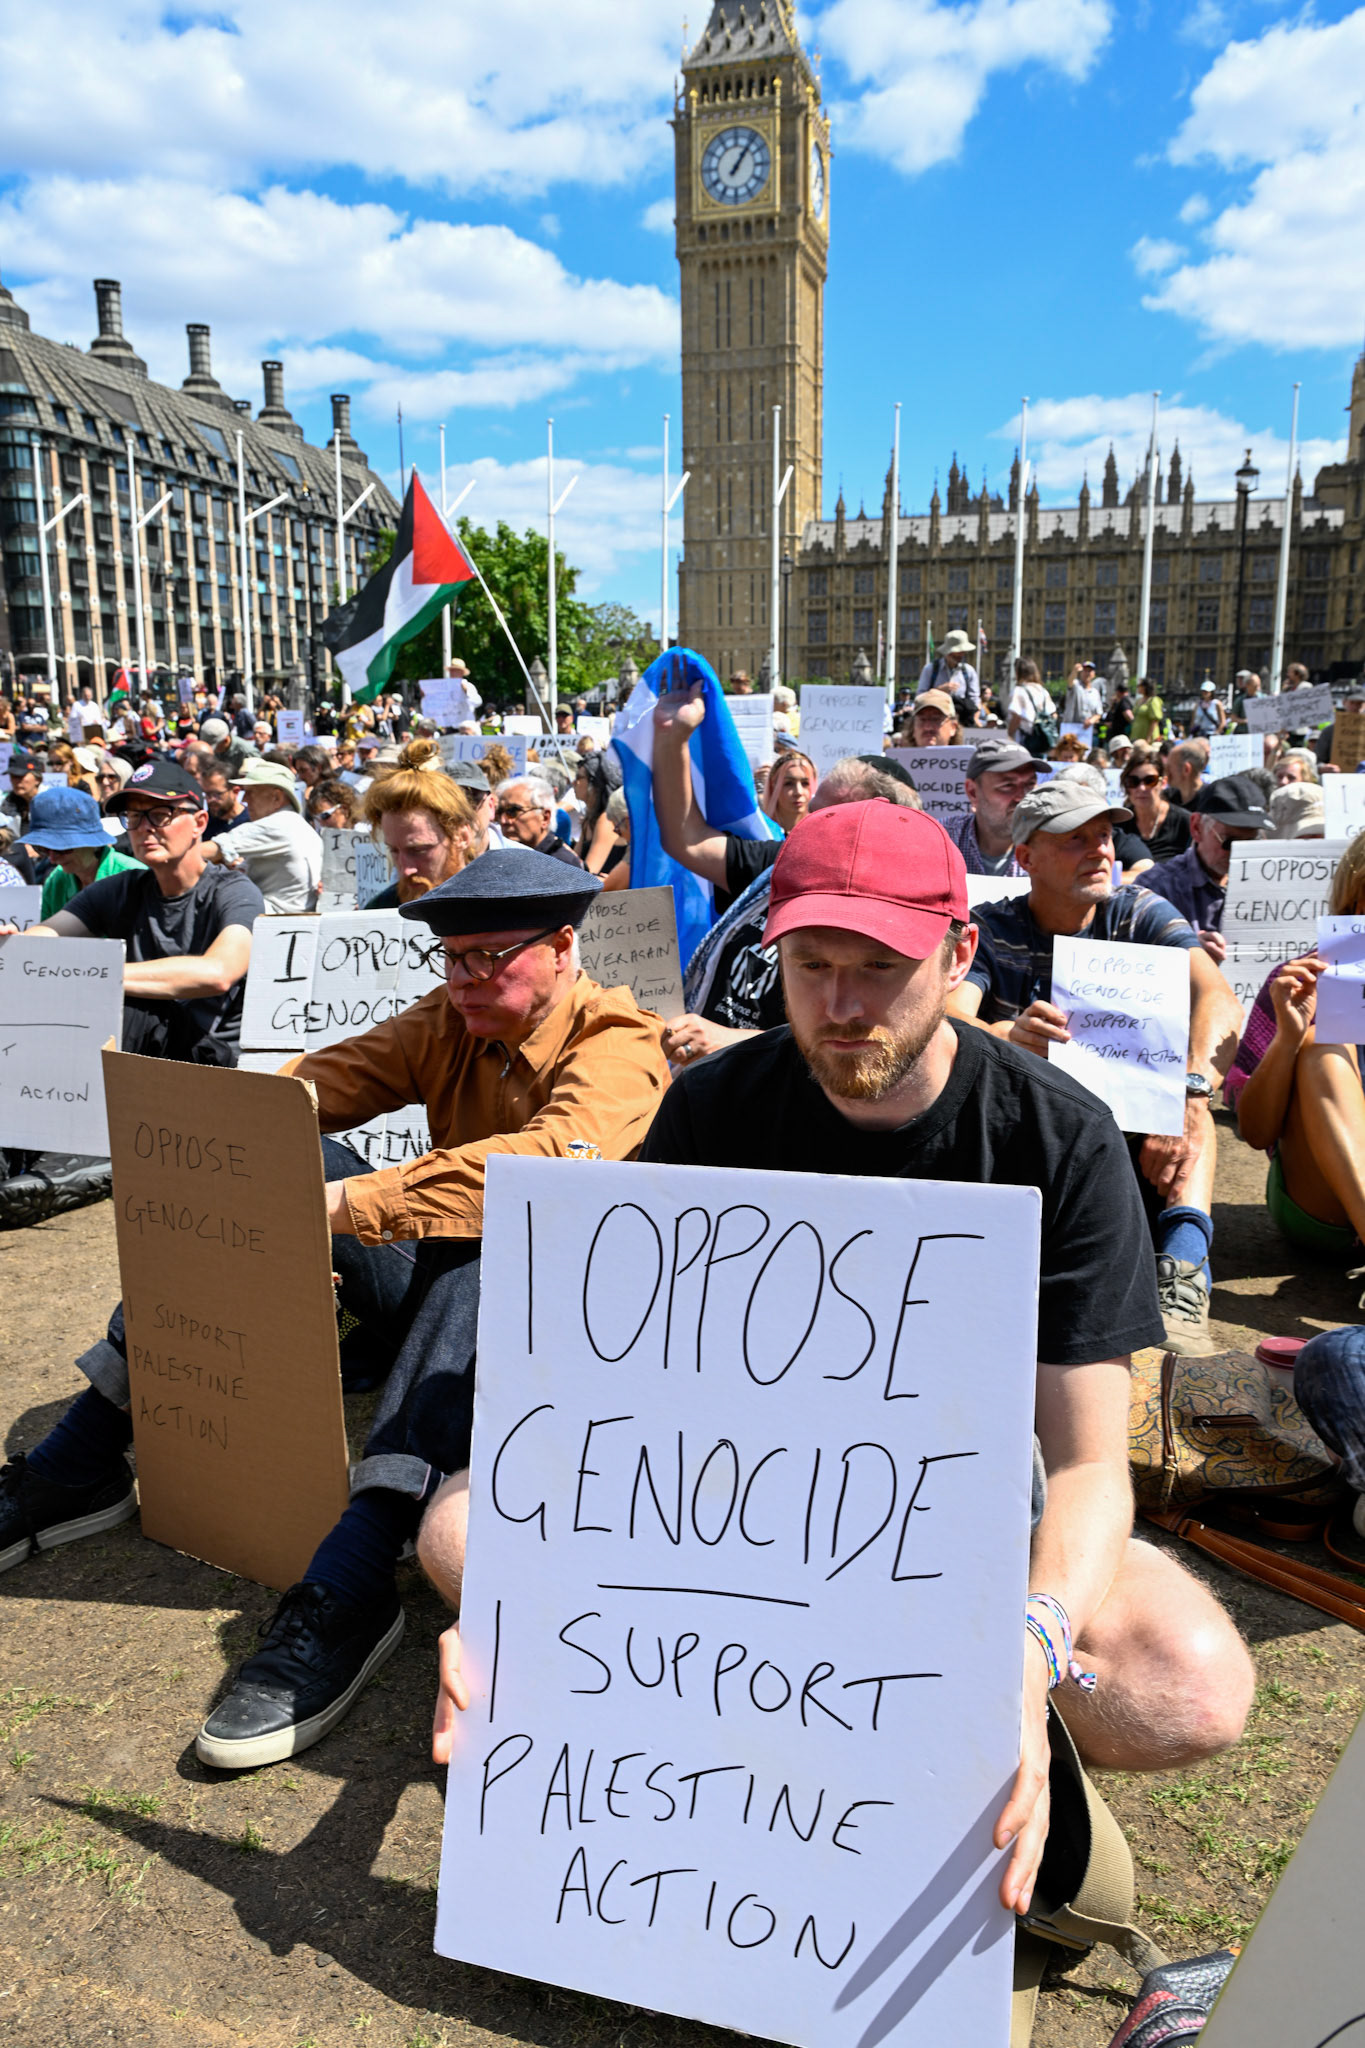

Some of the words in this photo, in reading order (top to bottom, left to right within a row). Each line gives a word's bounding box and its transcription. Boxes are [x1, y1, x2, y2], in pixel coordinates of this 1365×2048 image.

[819, 693, 868, 708] OPPOSE
[802, 715, 874, 733] GENOCIDE
[459, 741, 464, 760] I
[910, 758, 968, 772] OPPOSE
[922, 800, 972, 813] UPPORT
[331, 833, 341, 852] I
[1240, 859, 1249, 882] I
[1234, 898, 1329, 923] GENOCI
[579, 917, 661, 944] ENOCIDE
[272, 930, 313, 983] I
[580, 952, 629, 971] EVER
[1071, 951, 1076, 973] I
[1087, 956, 1157, 977] OPPOSE
[1232, 941, 1241, 963] I
[22, 960, 109, 979] GENOCIDE
[271, 994, 425, 1034] GENOCI
[1080, 1013, 1153, 1030] SUPPORT
[19, 1082, 89, 1103] ACTION
[134, 1121, 252, 1178] OPPOSE
[125, 1194, 266, 1254] GENOCIDE
[526, 1200, 533, 1354] I
[583, 1203, 985, 1400] OPPOSE
[127, 1295, 134, 1322] I
[153, 1303, 248, 1369] SUPPORT
[133, 1344, 249, 1400] PALESTINE
[139, 1395, 228, 1450] ACTION
[492, 1404, 979, 1581] GENOCIDE
[489, 1600, 501, 1723] I
[559, 1612, 943, 1731] SUPPORT
[479, 1733, 894, 1855] PALESTINE
[556, 1846, 856, 1969] ACTION
